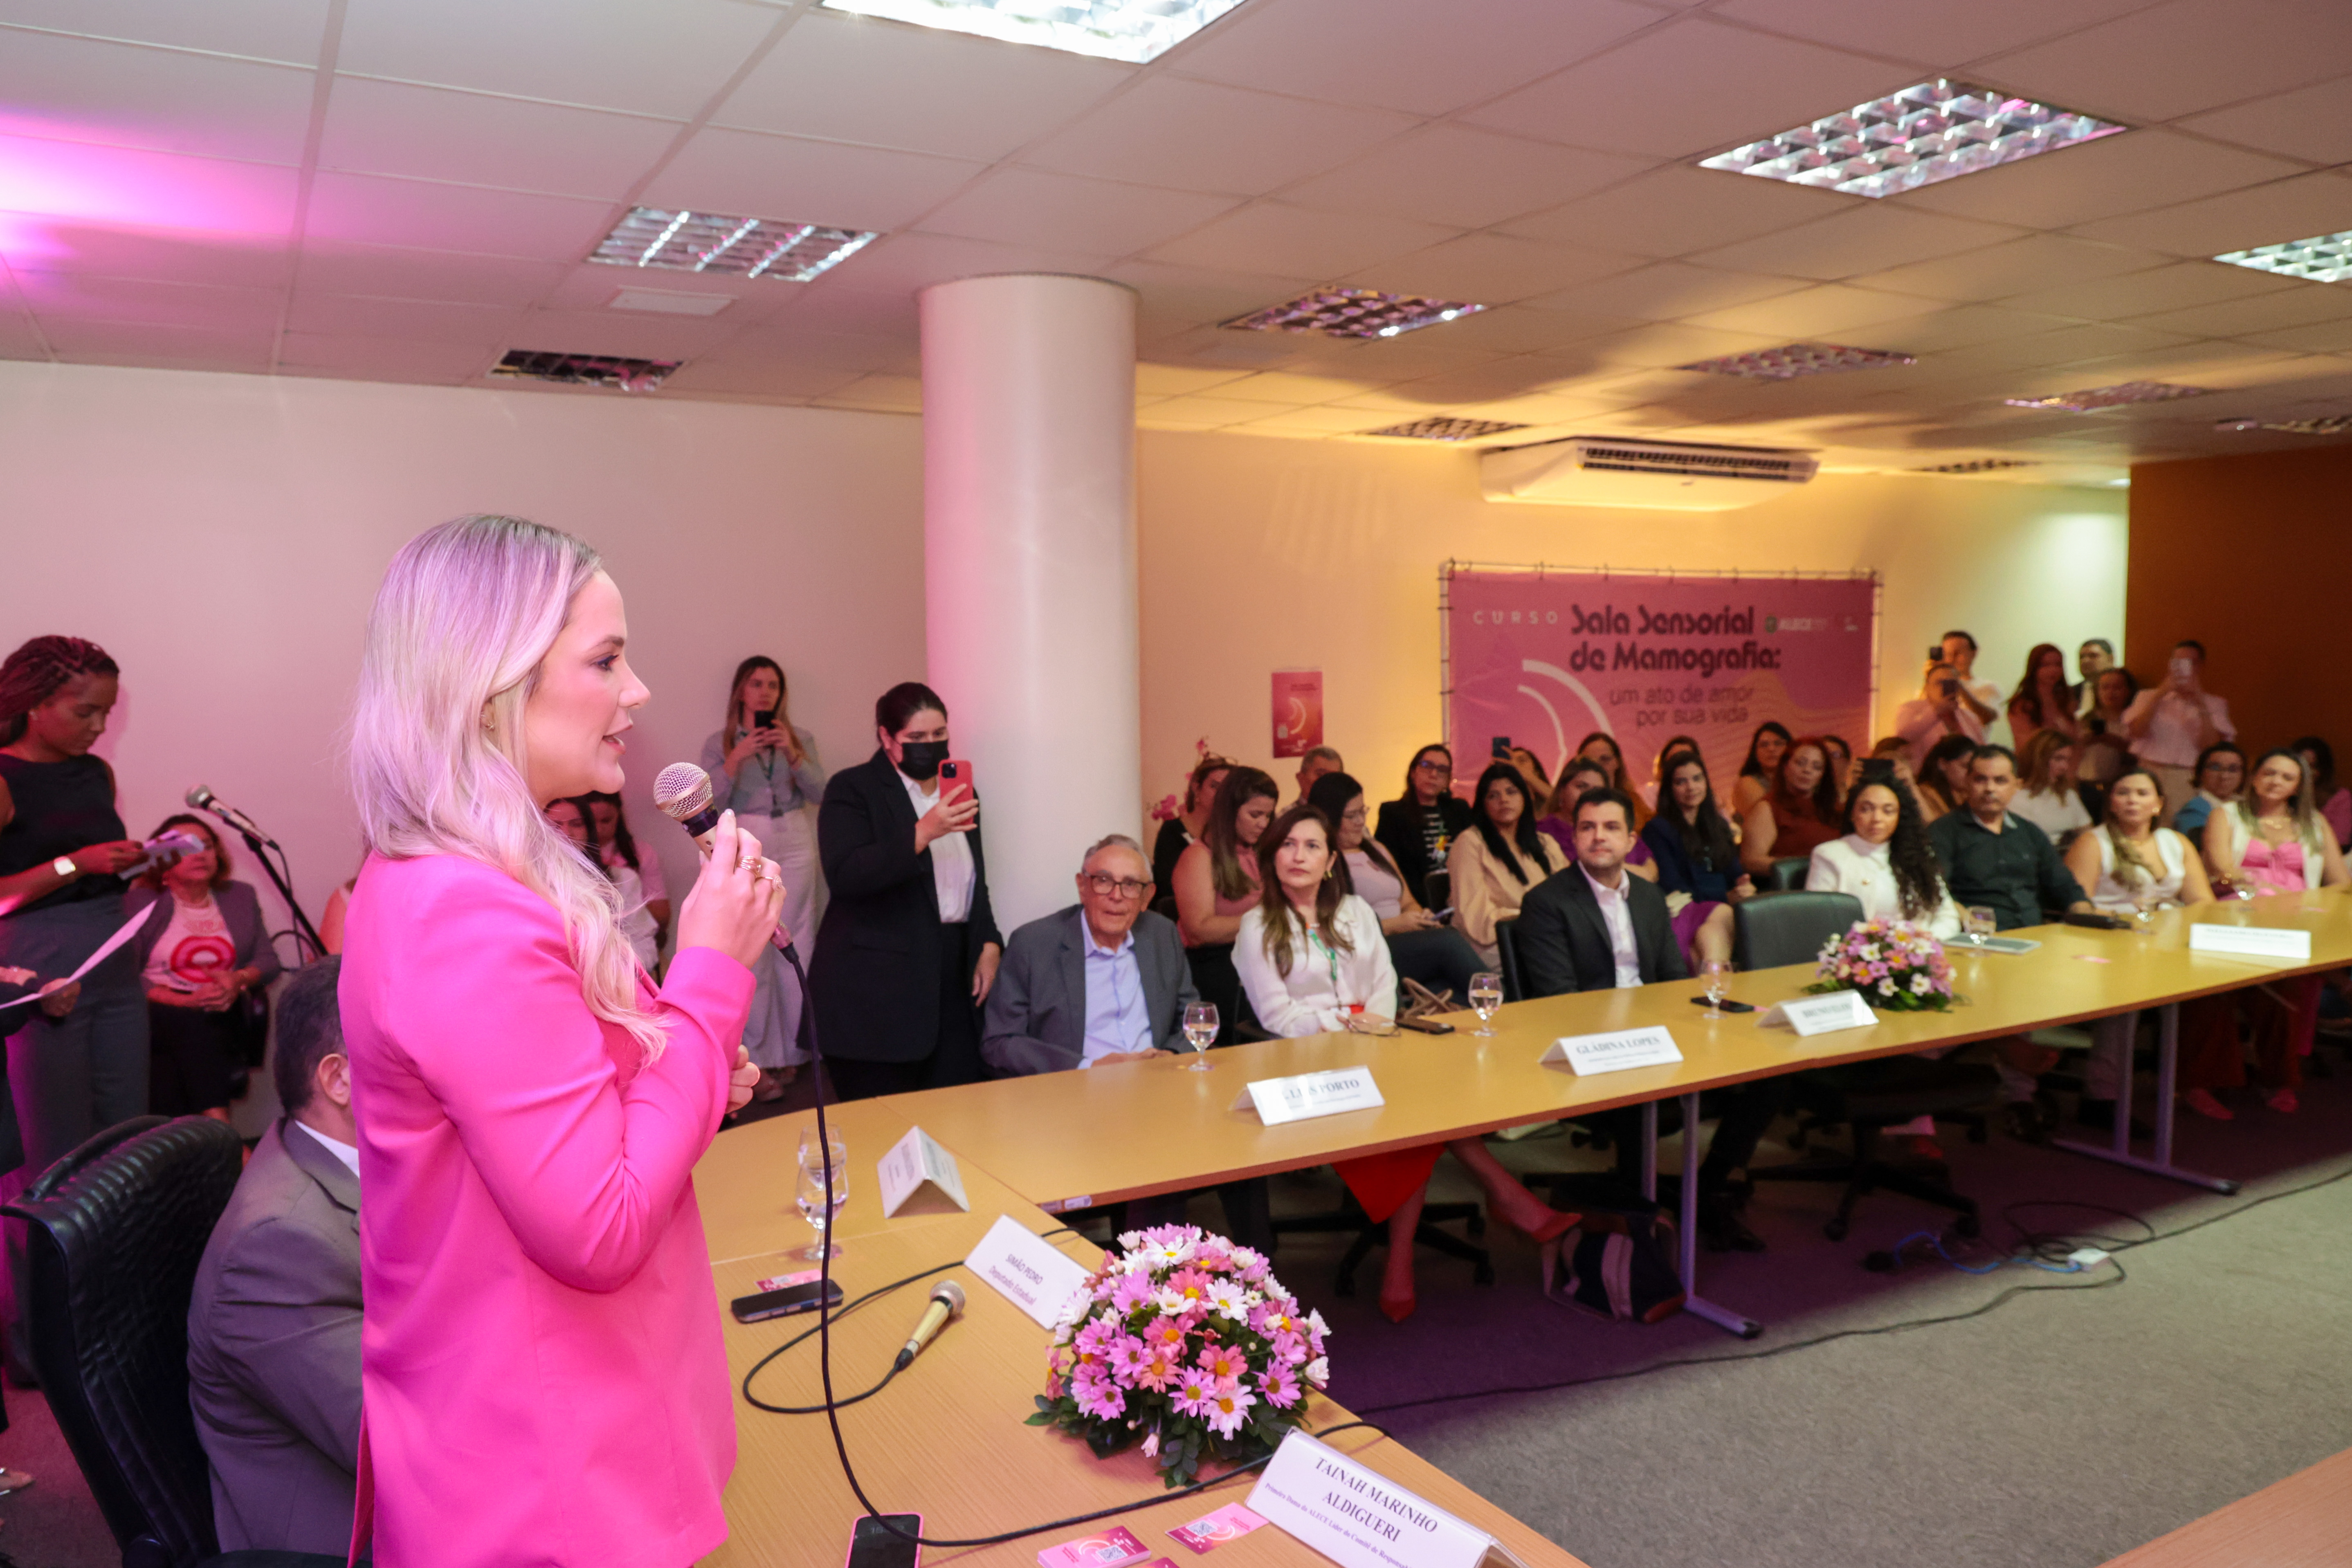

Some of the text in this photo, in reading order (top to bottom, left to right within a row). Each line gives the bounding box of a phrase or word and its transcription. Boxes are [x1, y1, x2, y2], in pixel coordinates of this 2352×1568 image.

[1473, 611, 1558, 625] CURSO
[1571, 604, 1754, 635] Sala Sensorial
[1570, 640, 1781, 678] de Mamografia:
[1609, 688, 1639, 706] um
[1645, 687, 1673, 705] ato
[1680, 684, 1703, 703] de
[1636, 706, 1749, 728] por sua vida
[1321, 1079, 1360, 1094] PORTO
[989, 1265, 1037, 1305] Deputado Estadual
[1006, 1254, 1043, 1285] SIMÃO PEDRO
[1265, 1483, 1286, 1499] Primeira
[1286, 1495, 1301, 1508] Dama
[1308, 1509, 1329, 1523] ALECE
[1315, 1457, 1438, 1533] TAINAH MARINHO
[1322, 1491, 1402, 1542] ALDIGUERI
